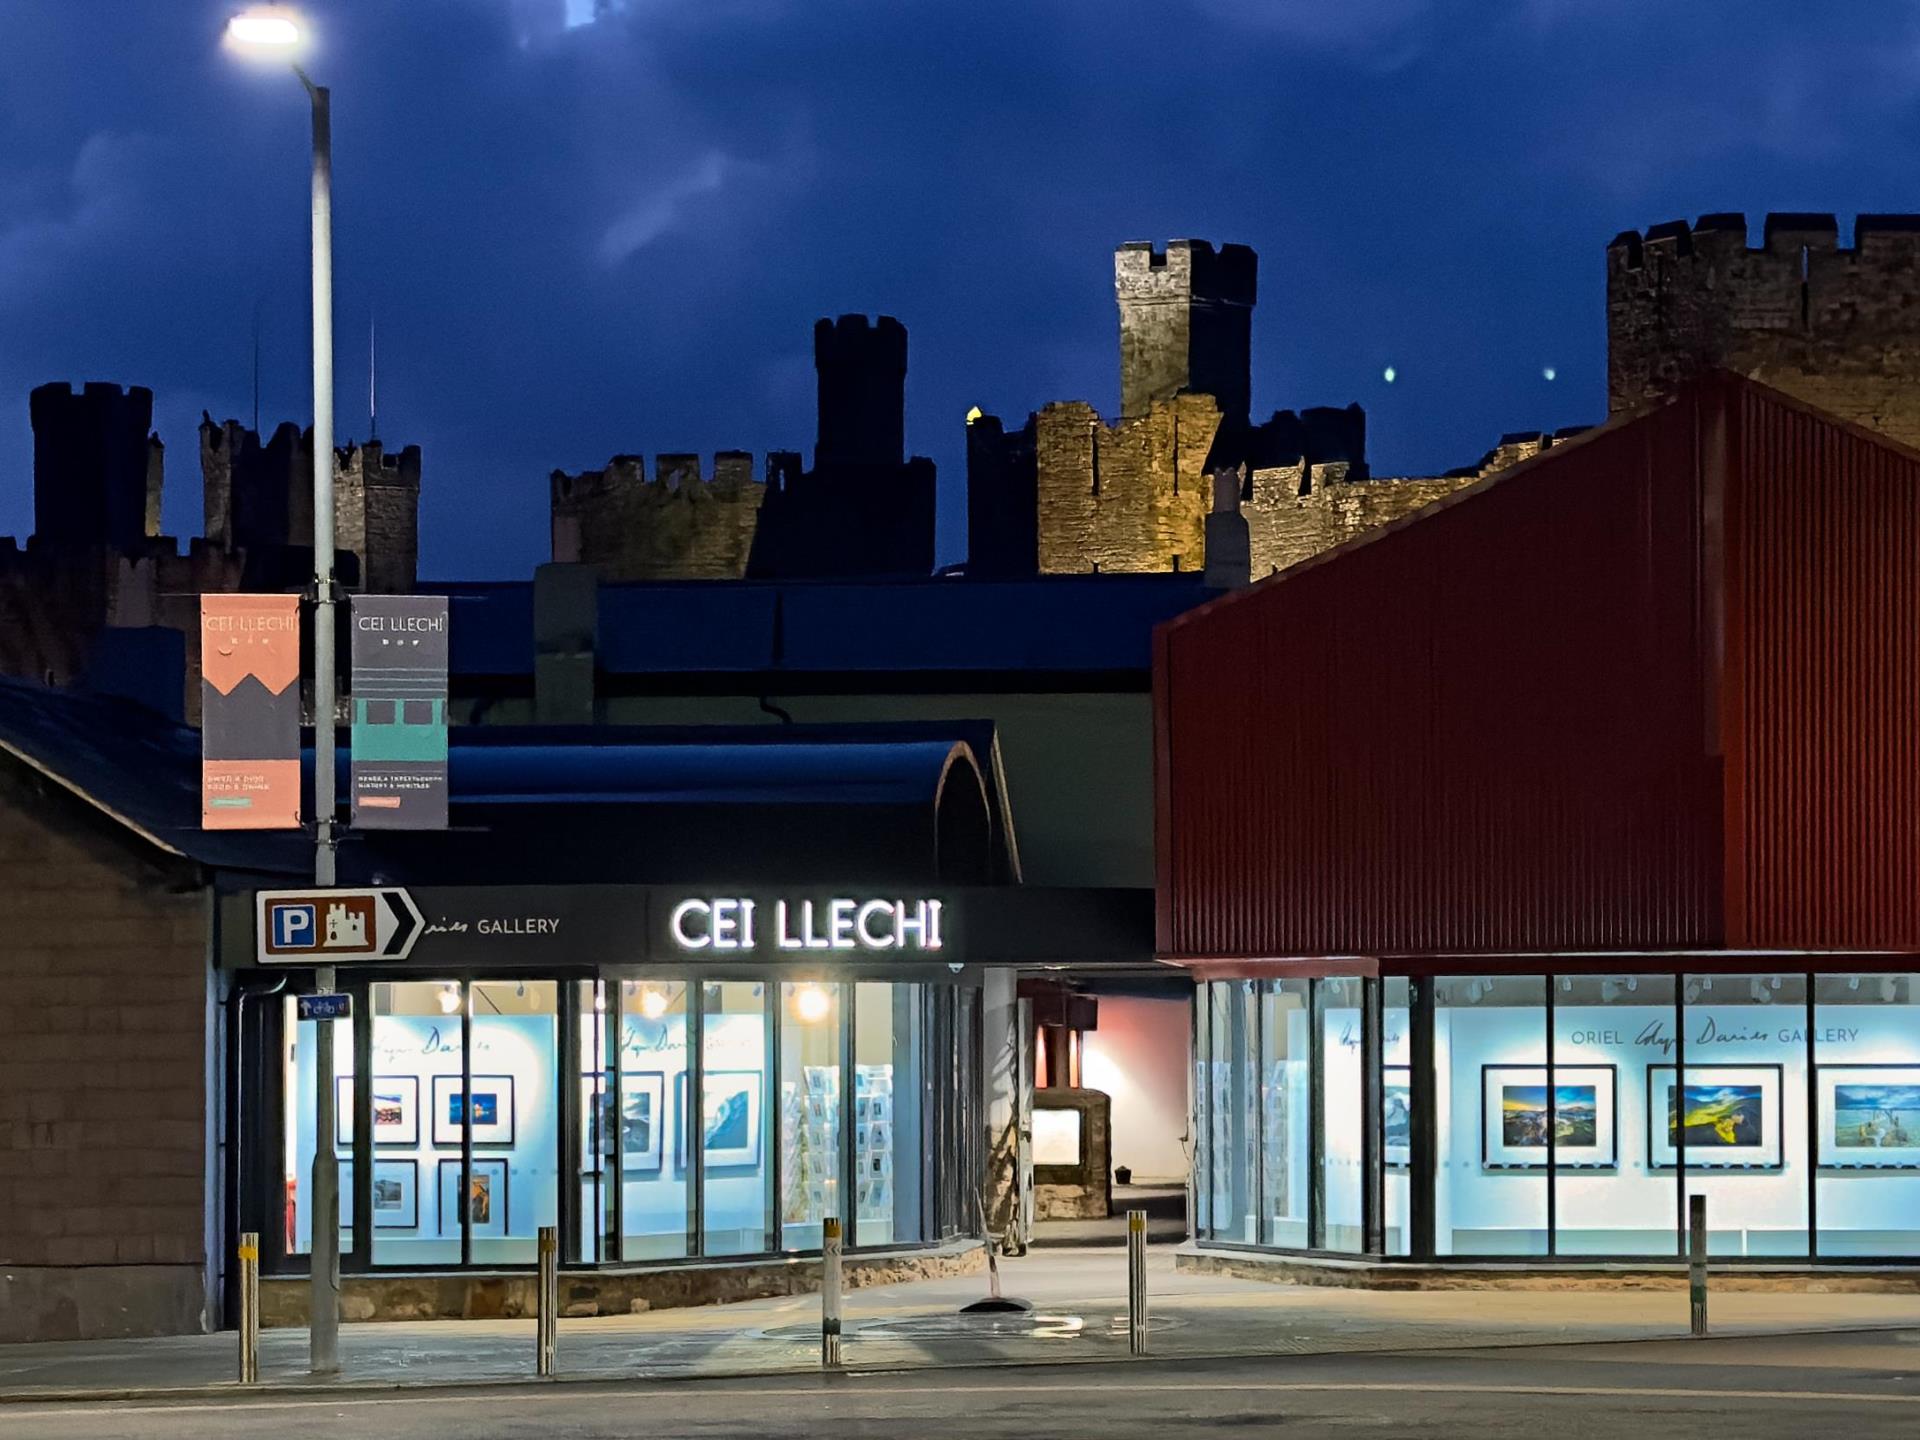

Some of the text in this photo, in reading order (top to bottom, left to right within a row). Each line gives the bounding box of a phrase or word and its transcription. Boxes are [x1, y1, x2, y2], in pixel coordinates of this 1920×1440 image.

[206, 616, 294, 631] CEI LLECHI
[358, 616, 443, 632] CEI LLECHI
[283, 909, 309, 944] P
[477, 917, 561, 934] GALLERY
[672, 898, 943, 948] CEI LLECHI
[1571, 1030, 1624, 1045] ORIEL
[1696, 1015, 1769, 1045] Davies
